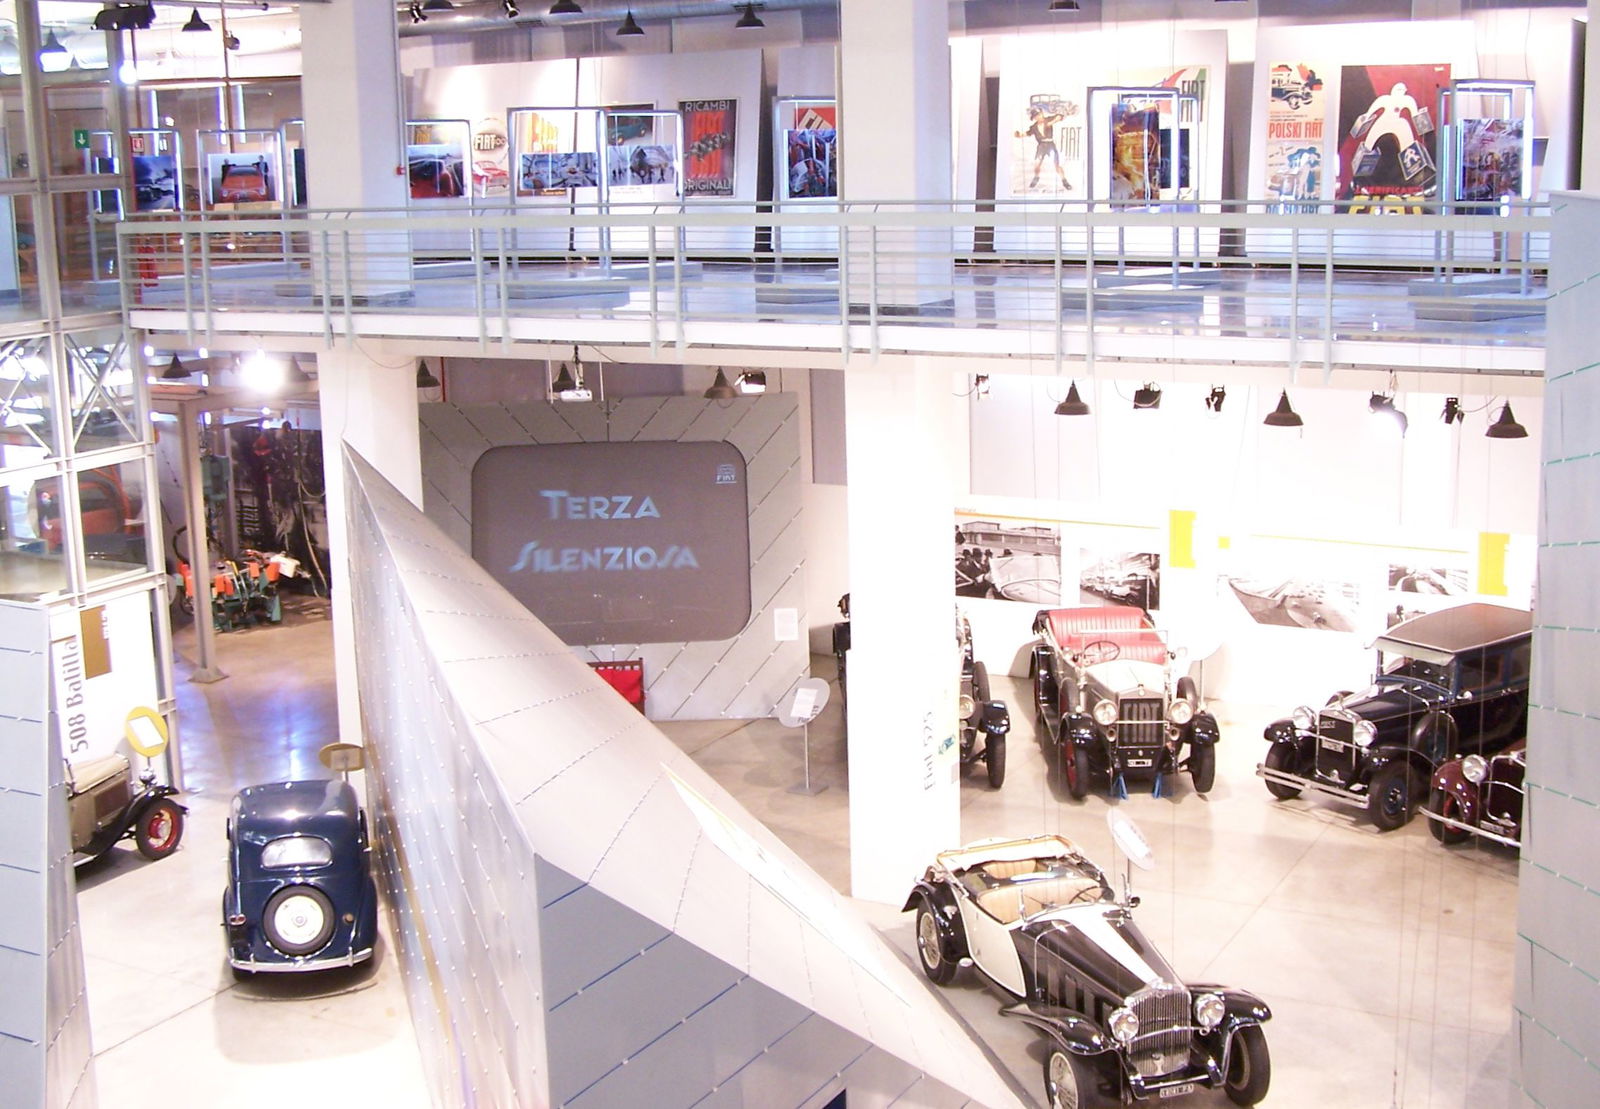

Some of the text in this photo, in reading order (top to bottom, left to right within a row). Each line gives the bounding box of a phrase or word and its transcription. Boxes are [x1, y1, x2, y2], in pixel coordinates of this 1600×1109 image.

[685, 101, 730, 112] RICAMBI
[474, 133, 496, 150] FIAT
[1060, 126, 1082, 160] FIAT
[1269, 122, 1302, 139] POLSKI
[540, 490, 661, 520] TERZA
[62, 639, 89, 754] 508 Balilla
[1123, 703, 1160, 743] FIAT
